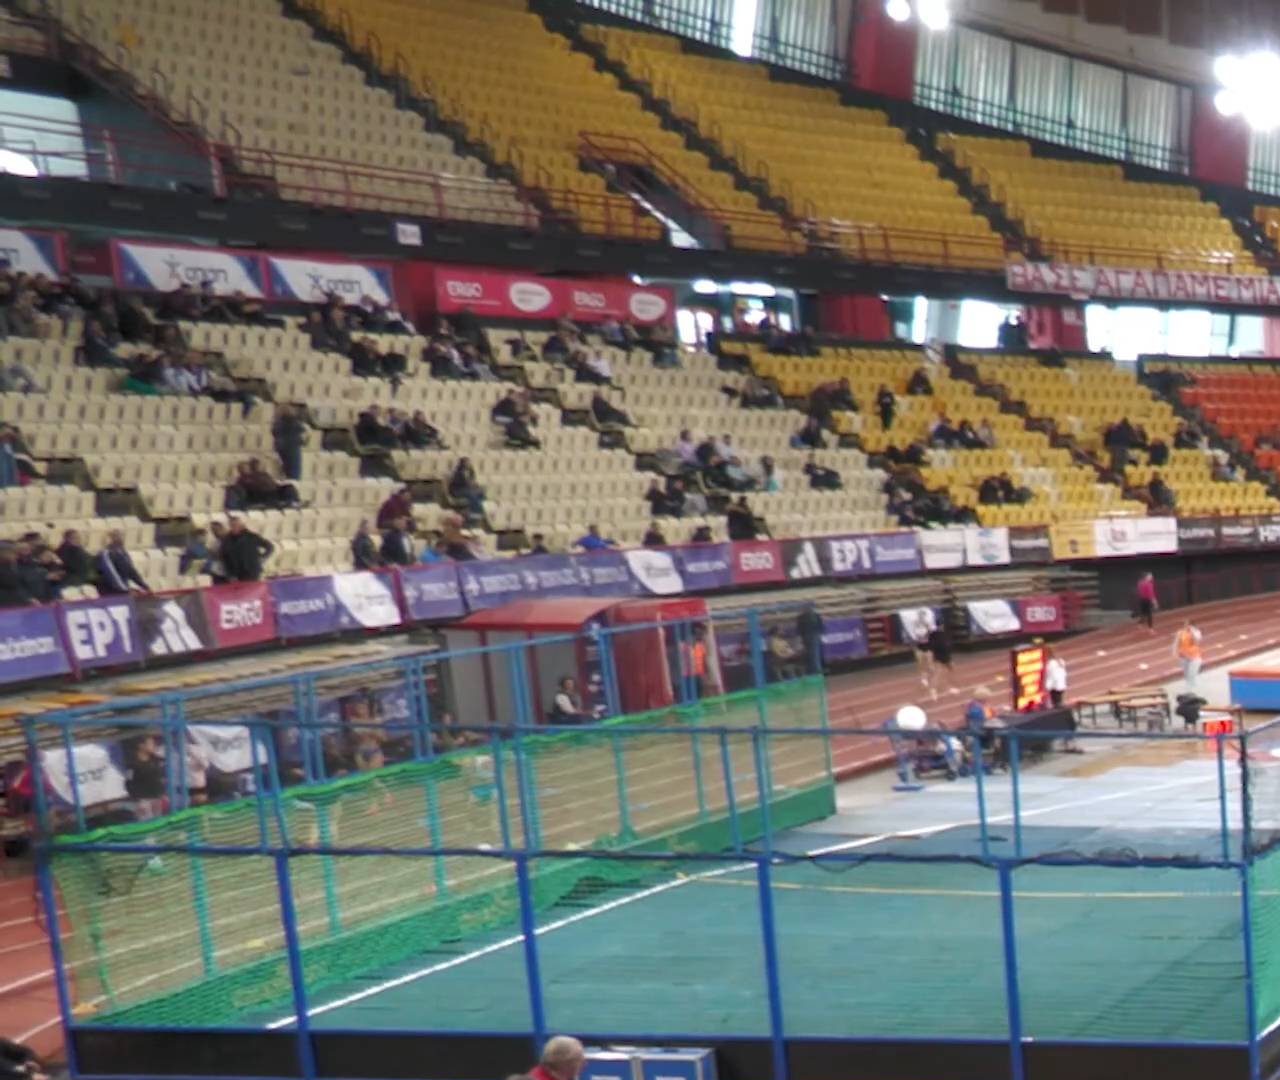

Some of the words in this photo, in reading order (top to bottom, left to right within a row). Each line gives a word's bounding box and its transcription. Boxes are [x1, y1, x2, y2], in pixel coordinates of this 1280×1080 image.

[447, 280, 483, 298] ERGO
[573, 291, 605, 308] ERGO
[739, 550, 774, 571] ERGO
[219, 600, 264, 630] ERGO
[1027, 606, 1057, 623] ERGO
